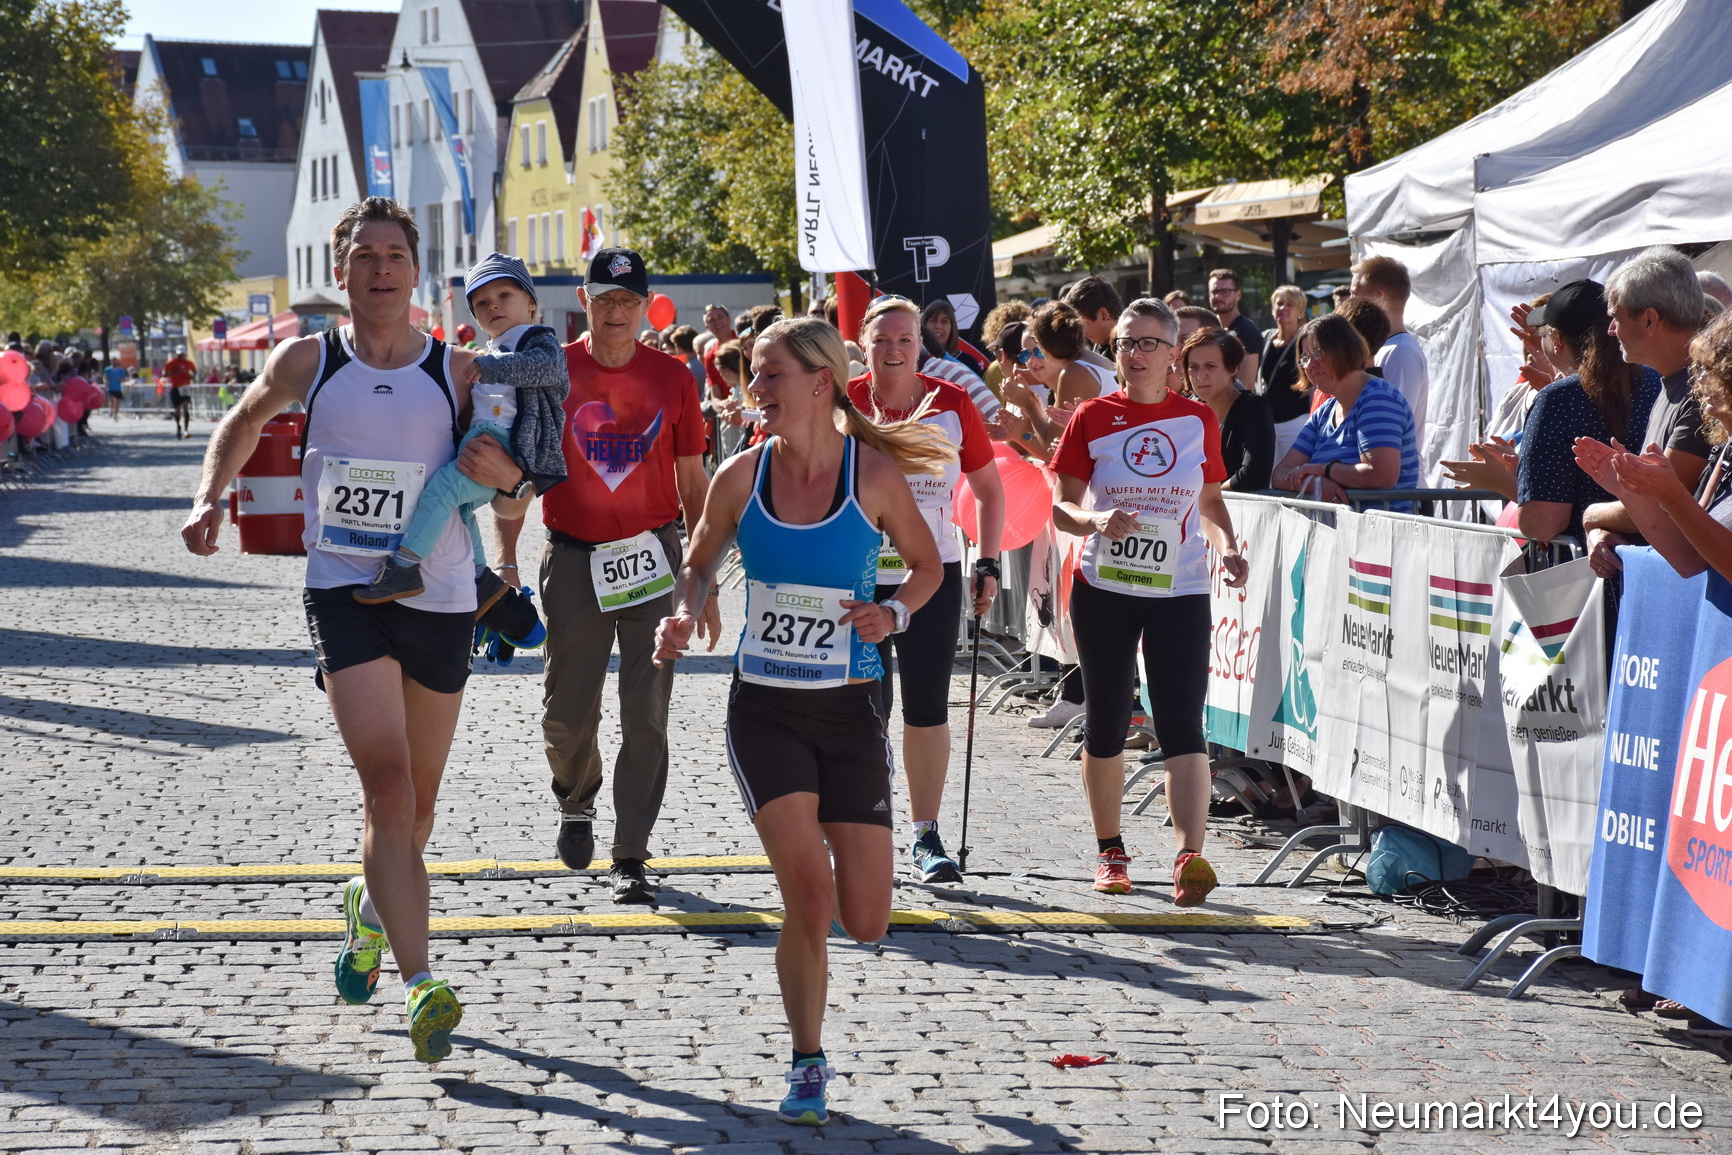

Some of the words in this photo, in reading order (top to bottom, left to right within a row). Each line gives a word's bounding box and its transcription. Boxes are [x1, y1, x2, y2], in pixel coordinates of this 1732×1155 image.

[349, 467, 396, 481] BOCK
[606, 463, 627, 473] 2017
[334, 485, 404, 520] 2371
[341, 518, 360, 527] PARTL
[361, 520, 392, 530] Neumarkt
[349, 532, 390, 549] Roland
[1110, 536, 1167, 563] 5070
[602, 549, 657, 583] 5073
[882, 558, 905, 568] Kers
[1113, 559, 1129, 567] PARTL
[1130, 561, 1154, 570] Neumarkt
[628, 575, 650, 587] Neumarkt
[1116, 570, 1153, 585] Carmen
[627, 587, 648, 600] Karl
[776, 592, 824, 609] BOCK
[760, 611, 835, 649] 2372
[763, 647, 784, 657] PARTL
[785, 651, 818, 660] Neumarkt
[764, 661, 823, 679] Christine
[1533, 725, 1578, 742] genießen
